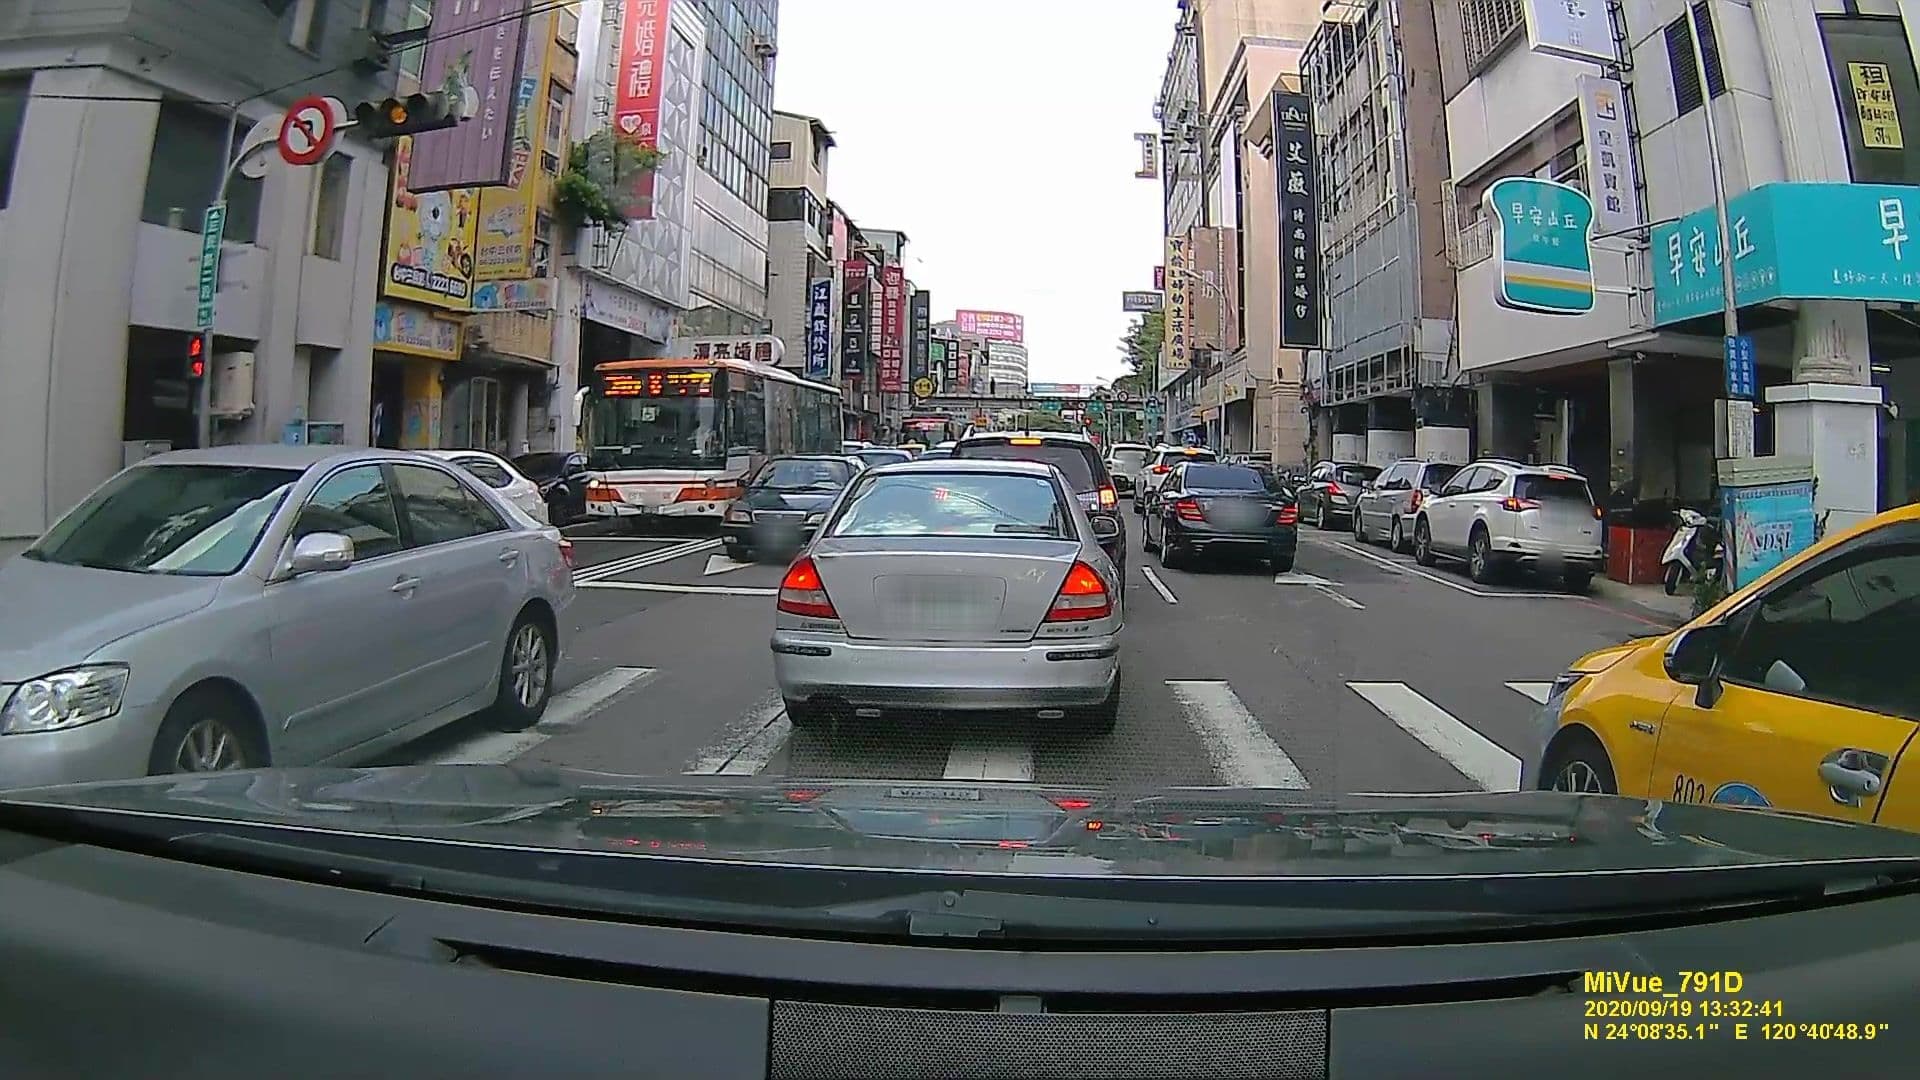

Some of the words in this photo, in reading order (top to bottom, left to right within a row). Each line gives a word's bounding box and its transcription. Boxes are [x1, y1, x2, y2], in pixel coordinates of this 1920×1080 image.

[1859, 65, 1885, 86] 租
[1511, 202, 1578, 230] 早安山丘
